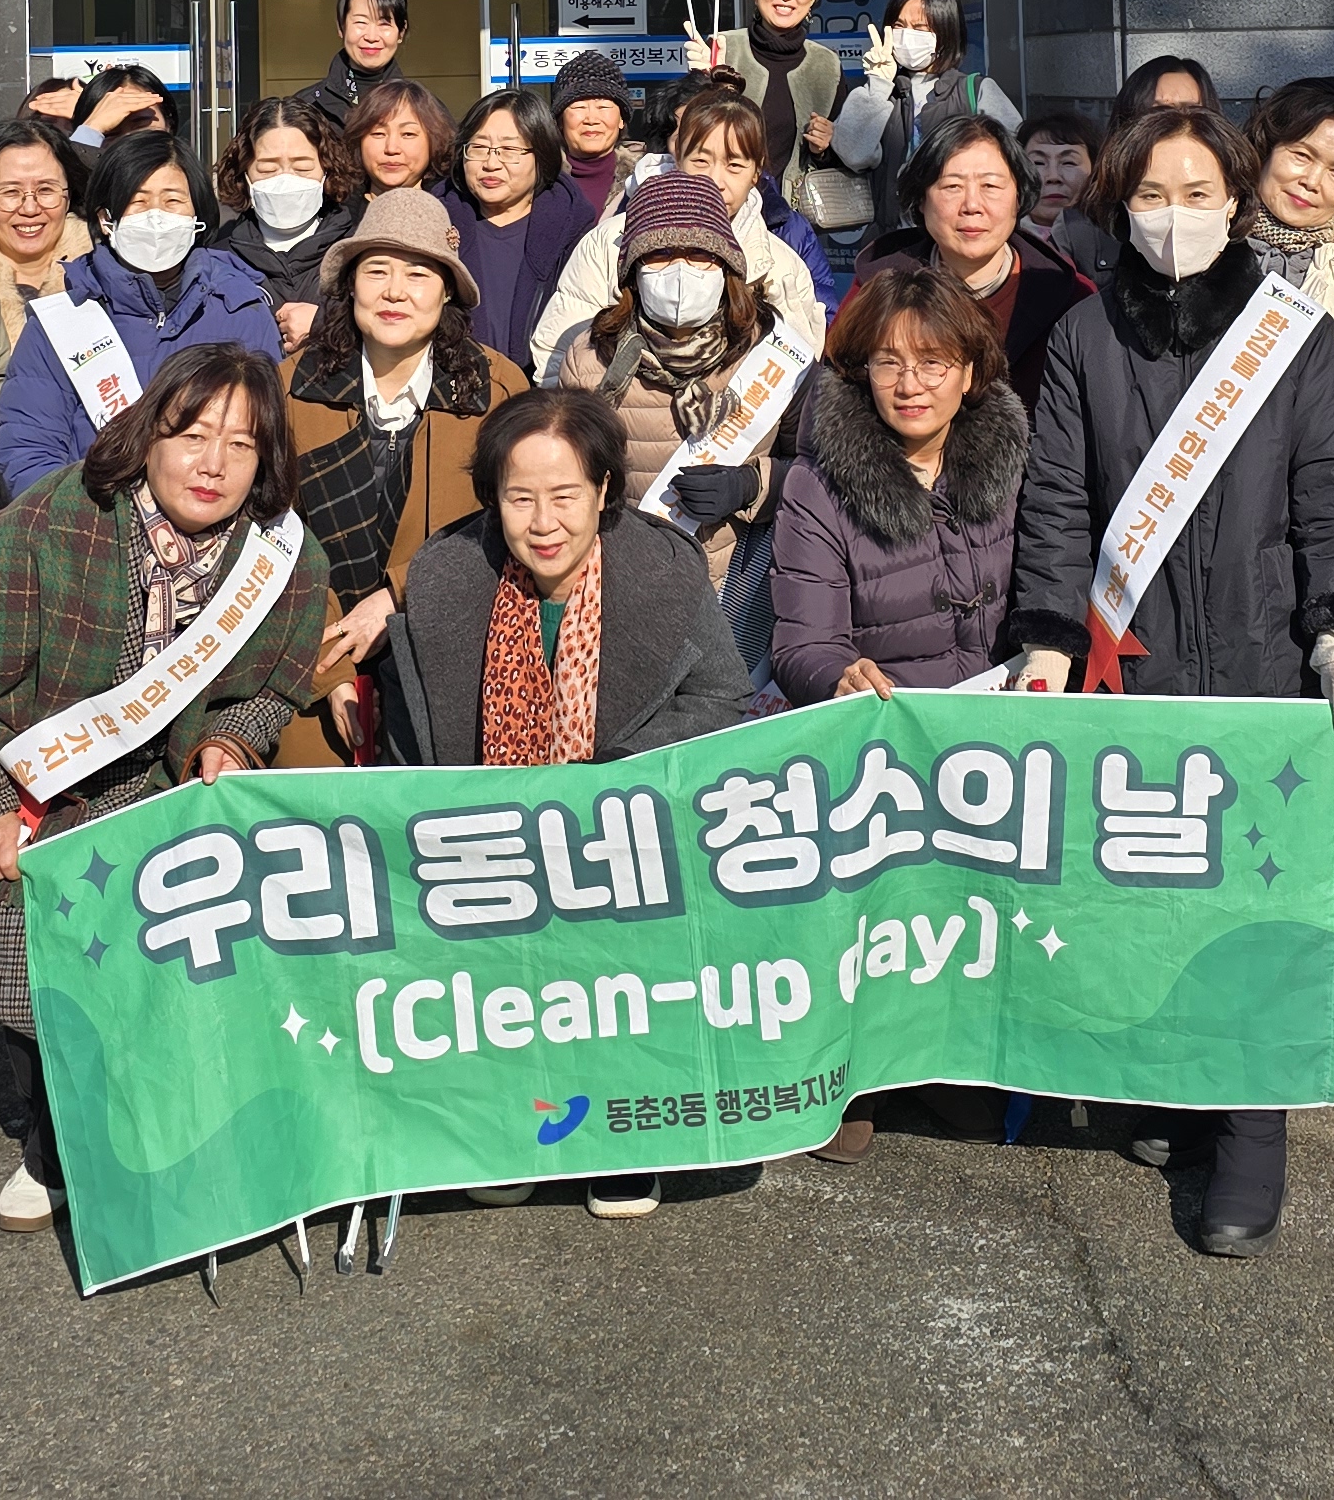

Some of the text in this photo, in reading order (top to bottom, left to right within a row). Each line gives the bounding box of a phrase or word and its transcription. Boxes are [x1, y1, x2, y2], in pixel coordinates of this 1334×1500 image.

[609, 46, 684, 67] 행정복지
[1267, 283, 1315, 318] Yeonsu
[68, 338, 114, 367] Yeonsu
[770, 330, 807, 366] Yeonsu
[1230, 308, 1292, 382] 환경을
[1194, 377, 1245, 432] 위한
[1165, 429, 1208, 482] 하루
[216, 553, 275, 636] 환경을
[1102, 561, 1131, 613] 실천
[167, 633, 222, 684] 위한
[121, 679, 172, 727] 하루
[141, 746, 1225, 971] 우리 동네 청소의 날
[606, 1058, 851, 1134] 동춘3동 행정복지센
